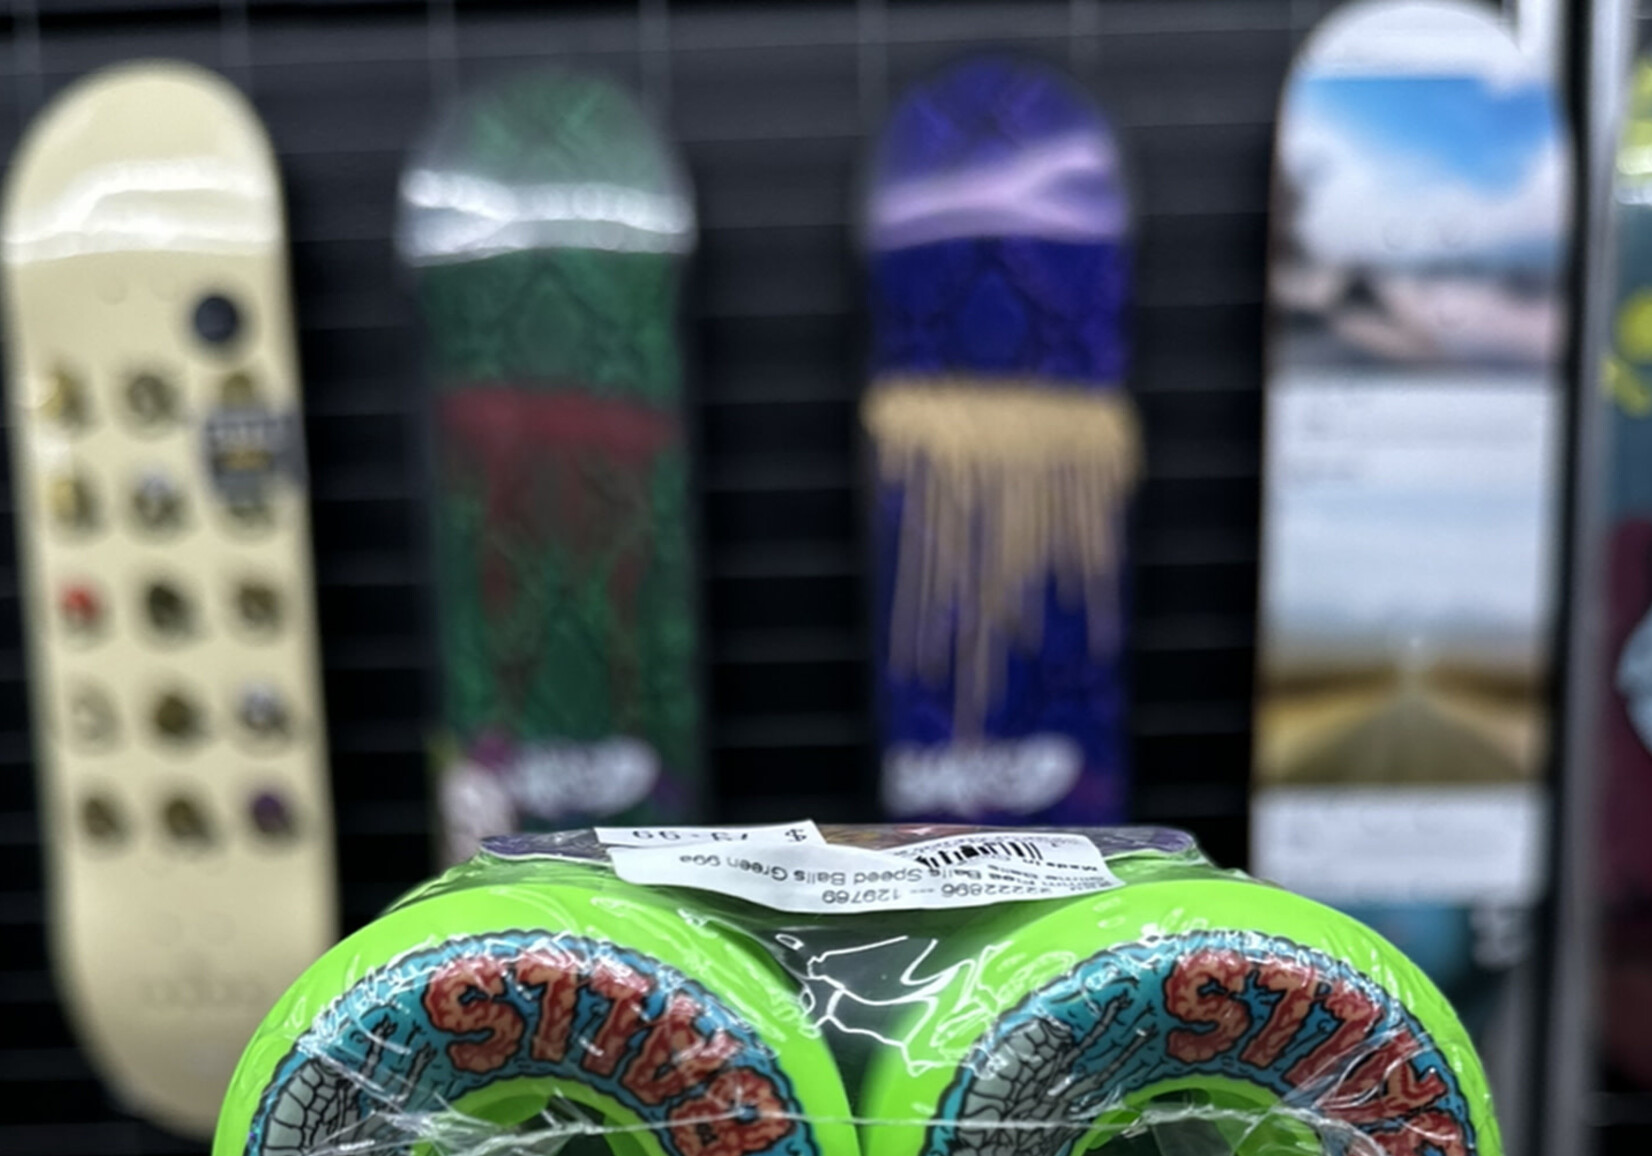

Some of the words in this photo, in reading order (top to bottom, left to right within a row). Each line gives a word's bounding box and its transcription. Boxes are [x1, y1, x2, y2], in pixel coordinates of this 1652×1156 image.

[726, 856, 788, 881] Green
[793, 870, 847, 885] Balls
[853, 868, 922, 886] Speed
